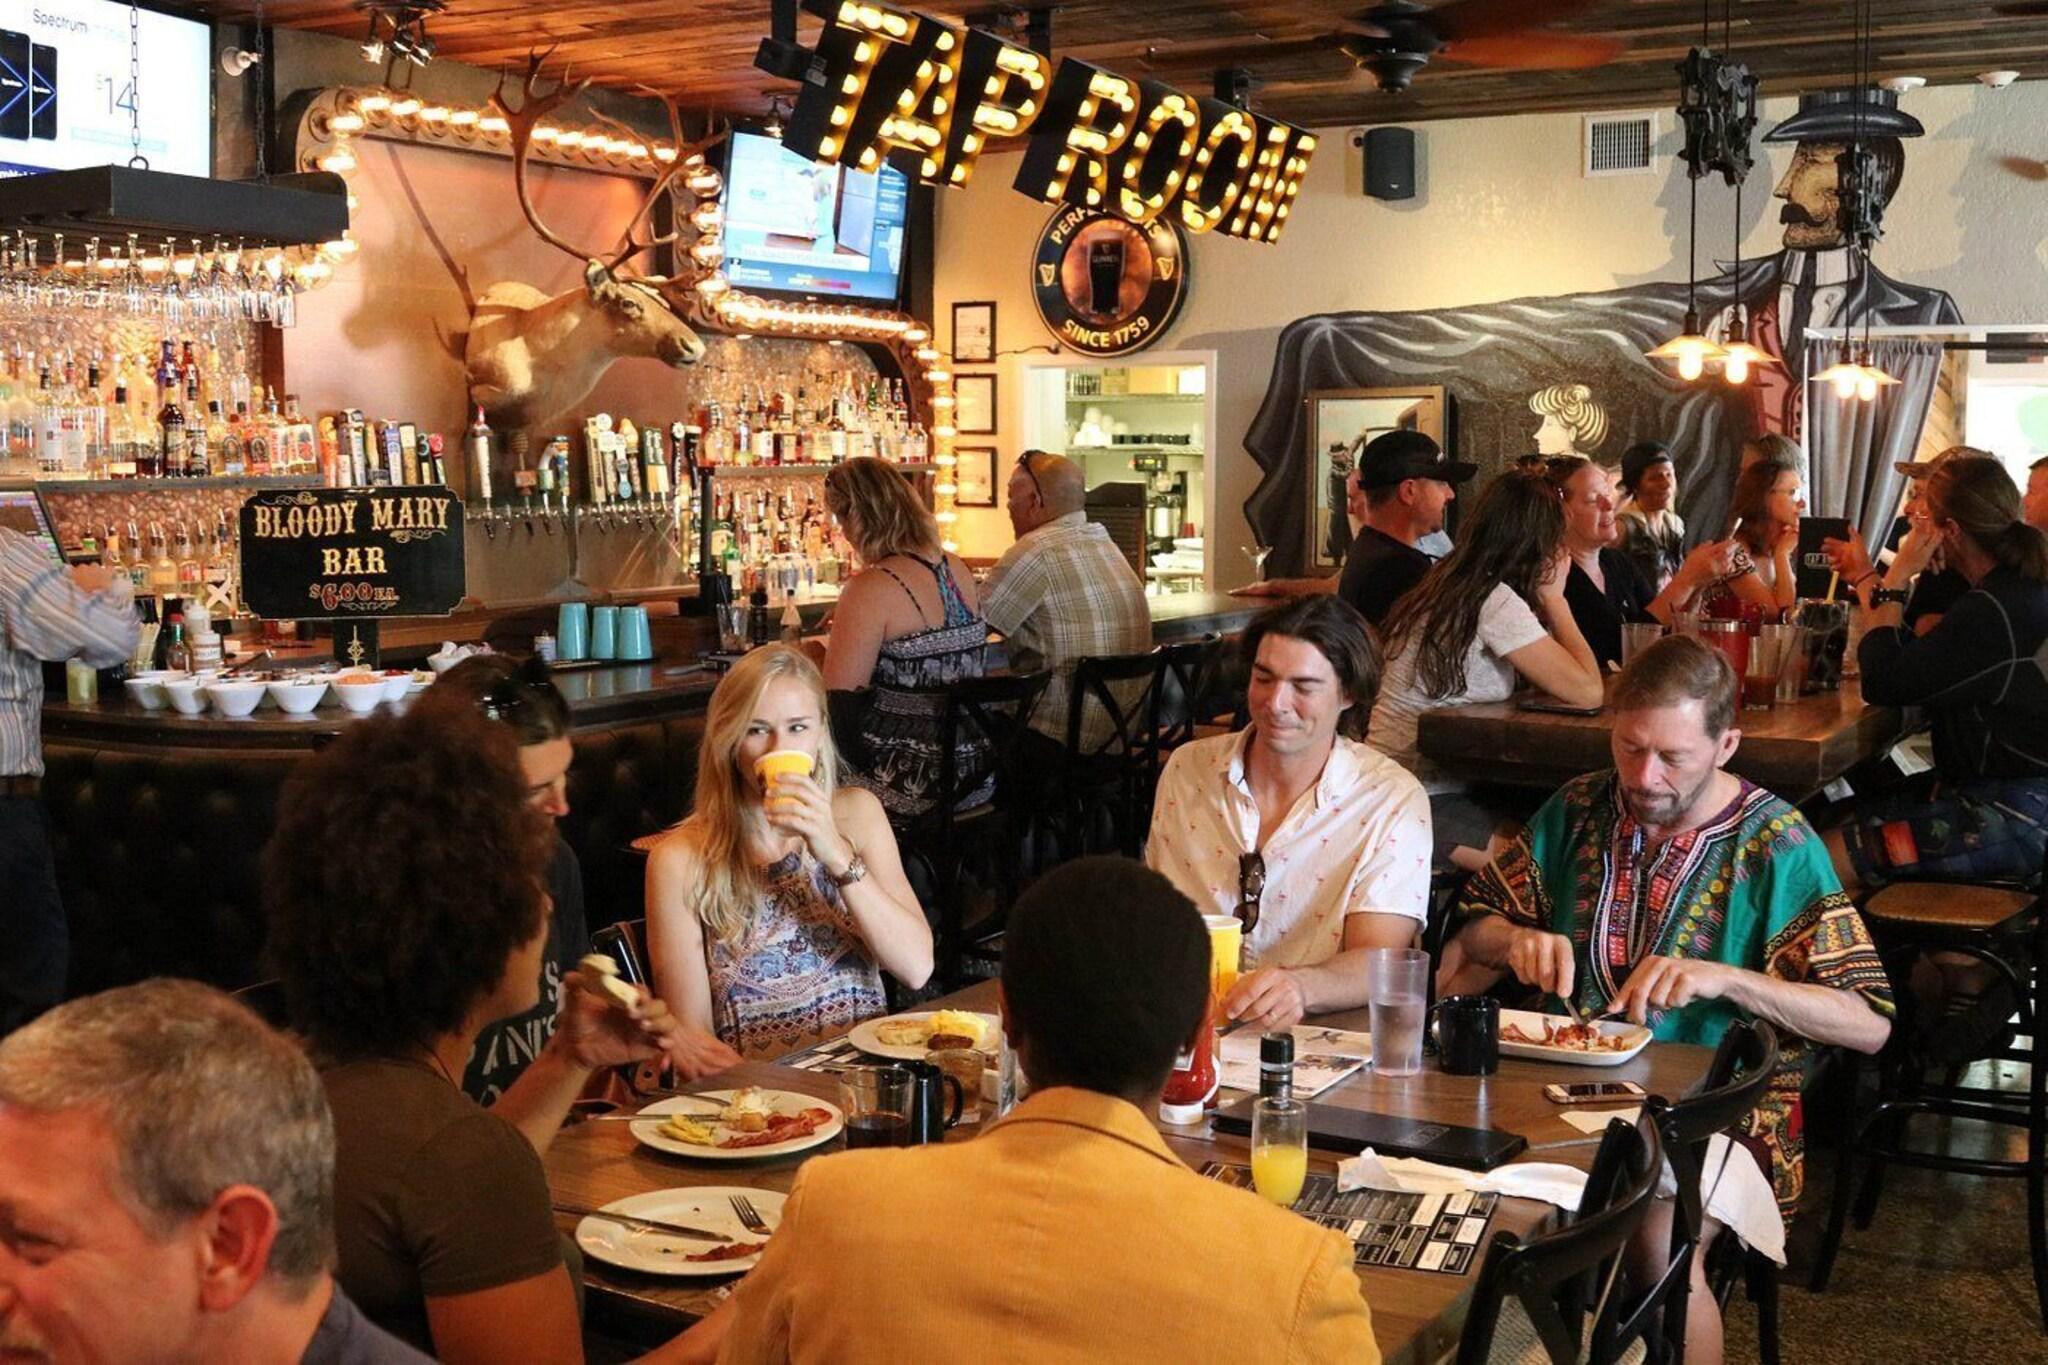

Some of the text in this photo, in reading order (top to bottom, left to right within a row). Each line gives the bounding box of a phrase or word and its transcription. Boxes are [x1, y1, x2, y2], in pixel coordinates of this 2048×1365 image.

[32, 8, 88, 34] Spectrum
[818, 0, 1319, 245] TAP ROOM
[1062, 316, 1150, 348] SINCE 1759
[254, 498, 451, 539] BLOODY MARY
[321, 546, 388, 576] BAR
